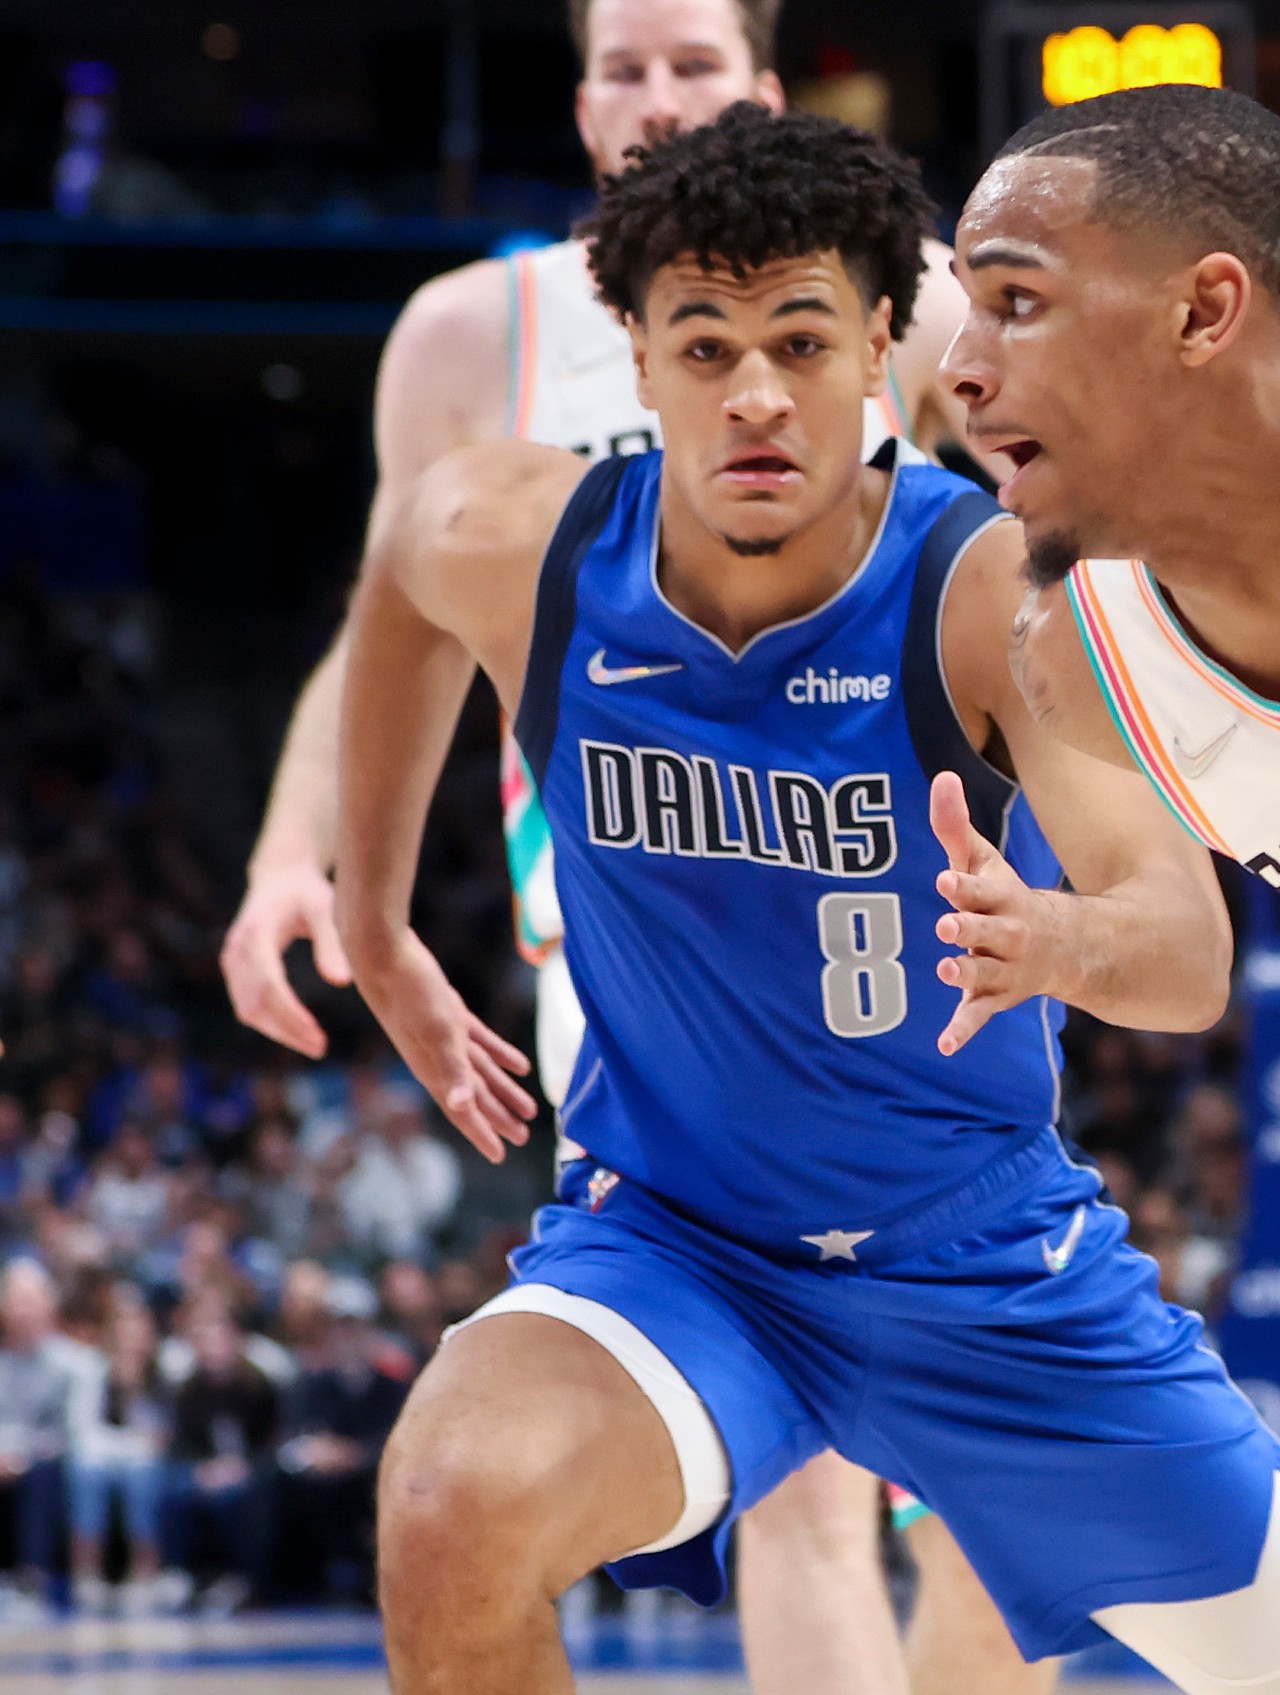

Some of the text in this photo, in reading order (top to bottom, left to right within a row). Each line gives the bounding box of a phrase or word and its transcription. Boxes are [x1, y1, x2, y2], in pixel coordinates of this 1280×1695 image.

[785, 667, 892, 704] chime
[578, 738, 899, 879] DALLAS
[815, 891, 908, 1039] 8
